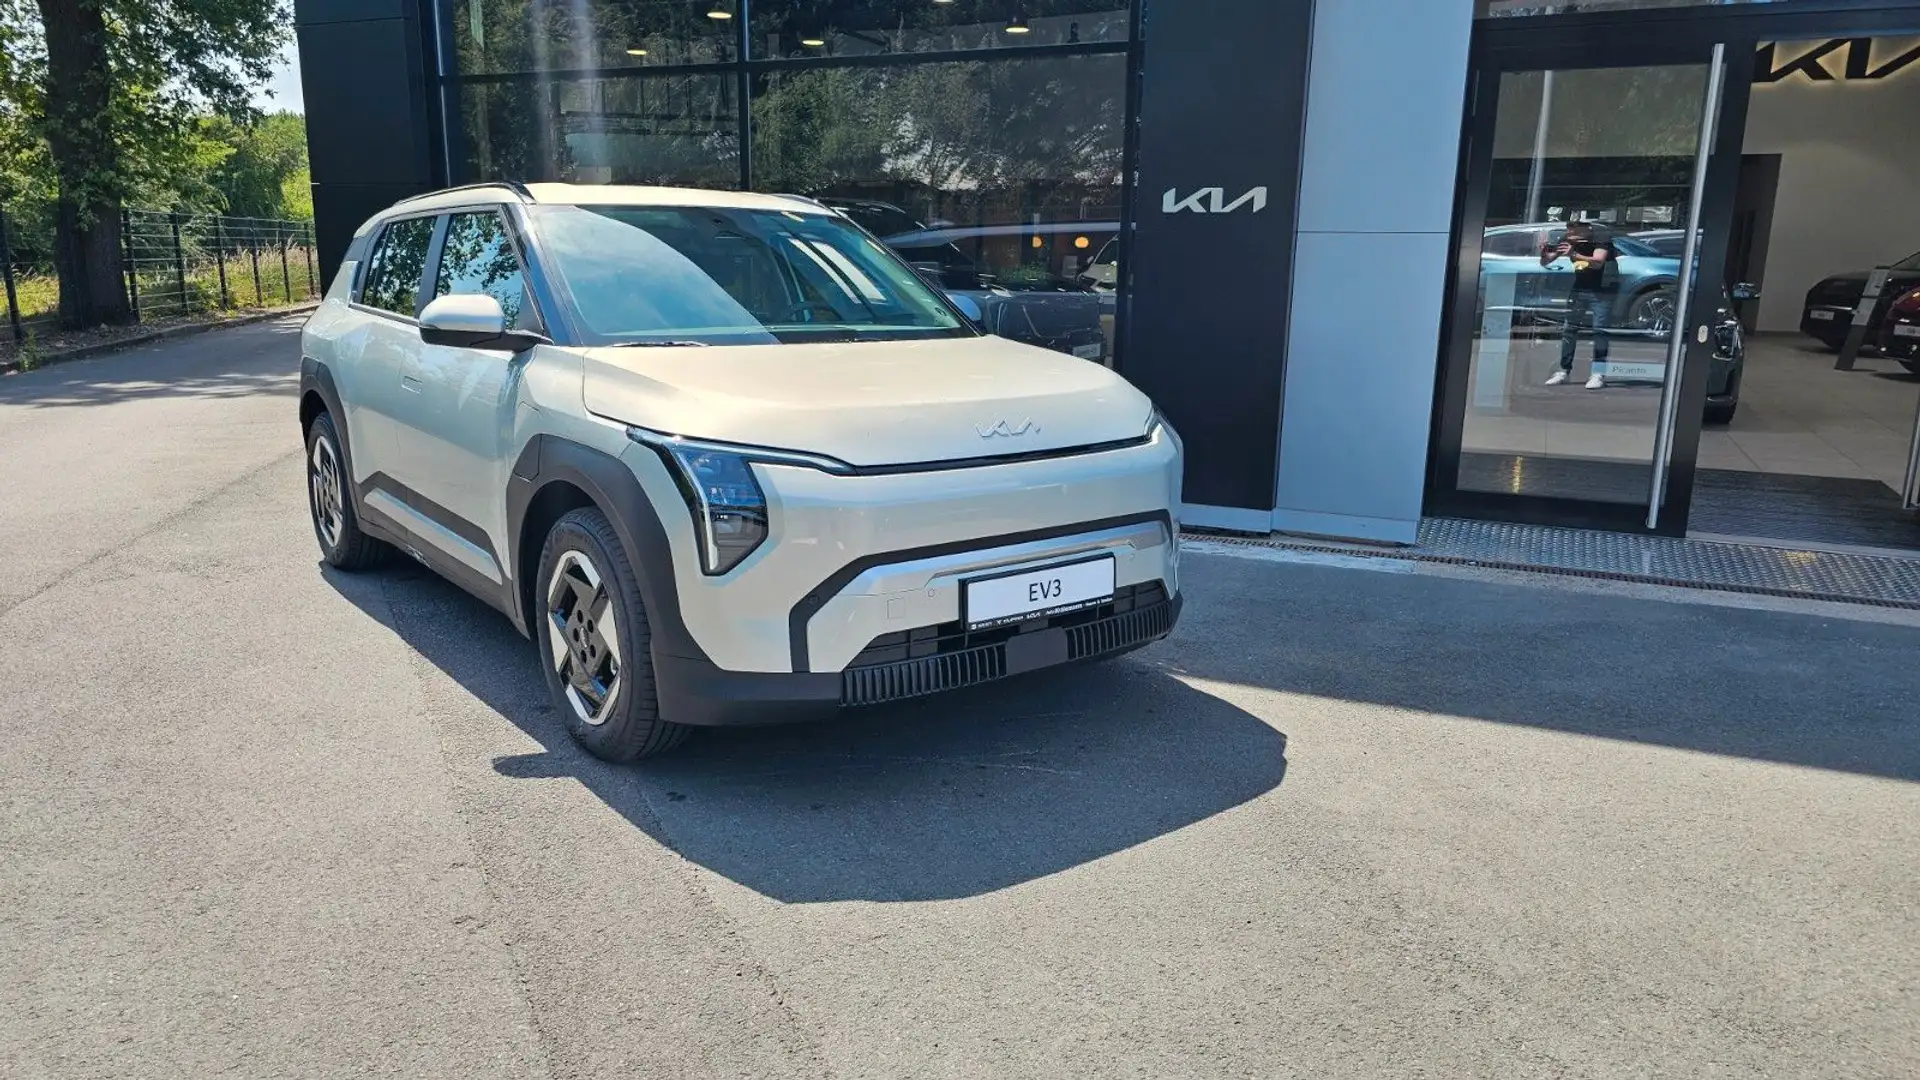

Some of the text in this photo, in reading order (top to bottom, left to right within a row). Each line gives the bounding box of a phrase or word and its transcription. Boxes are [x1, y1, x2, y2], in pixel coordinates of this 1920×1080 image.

[1162, 186, 1267, 213] KIA
[975, 417, 1040, 437] KIA
[1028, 578, 1062, 602] EV3
